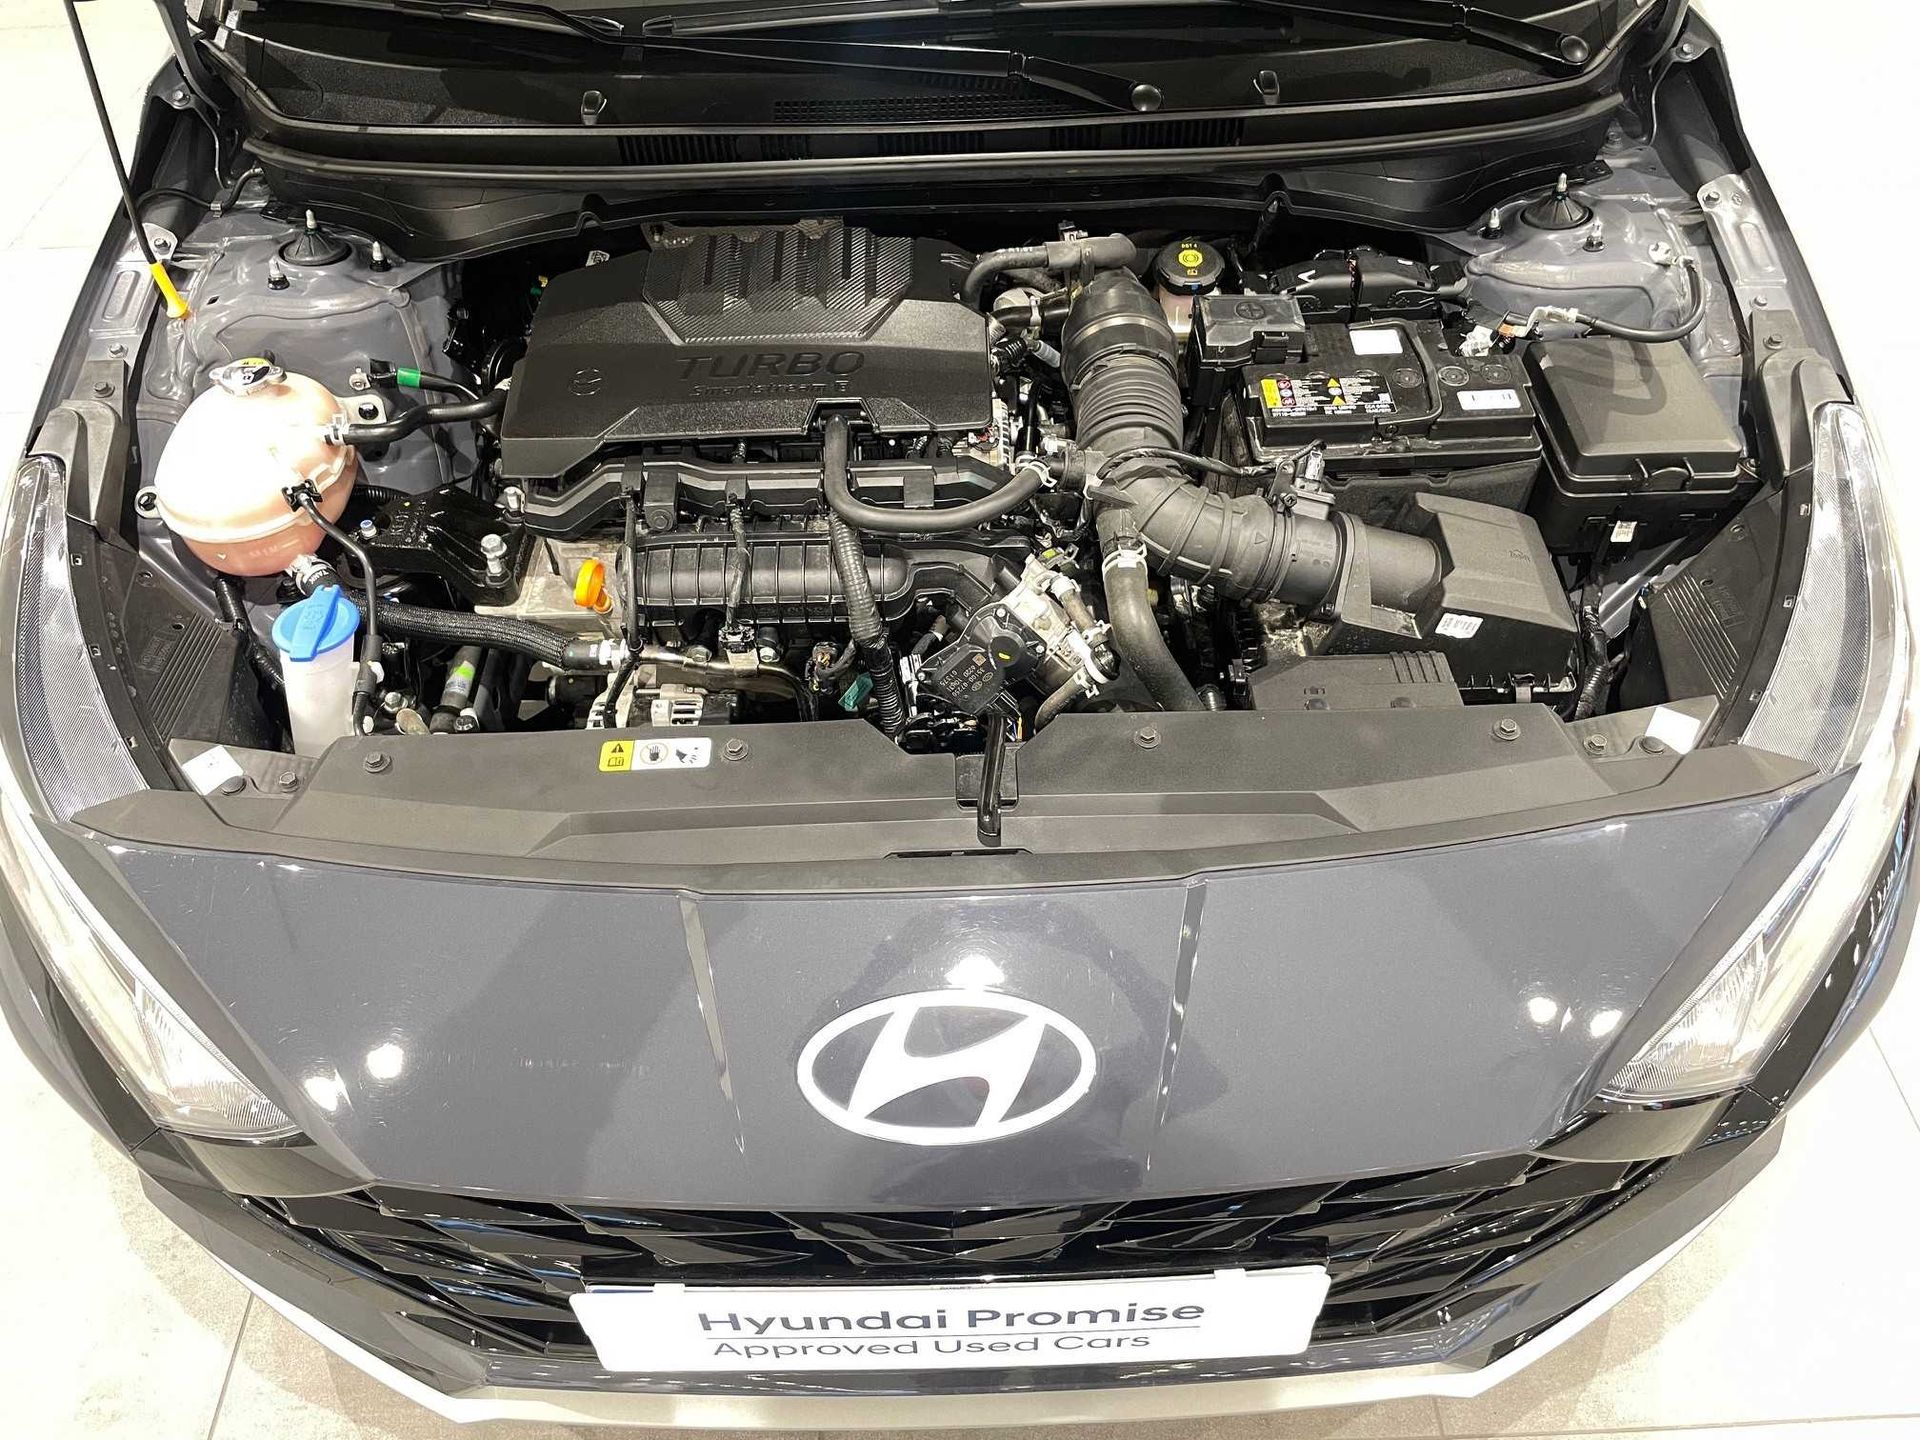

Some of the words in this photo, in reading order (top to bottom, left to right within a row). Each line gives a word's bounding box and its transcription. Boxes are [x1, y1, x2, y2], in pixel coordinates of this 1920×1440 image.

[676, 352, 865, 382] TURBO
[698, 1309, 947, 1335] Hyundai
[967, 1303, 1205, 1328] Promise
[713, 1342, 918, 1359] Approved
[934, 1336, 1039, 1354] Used
[1053, 1335, 1150, 1350] Cars
